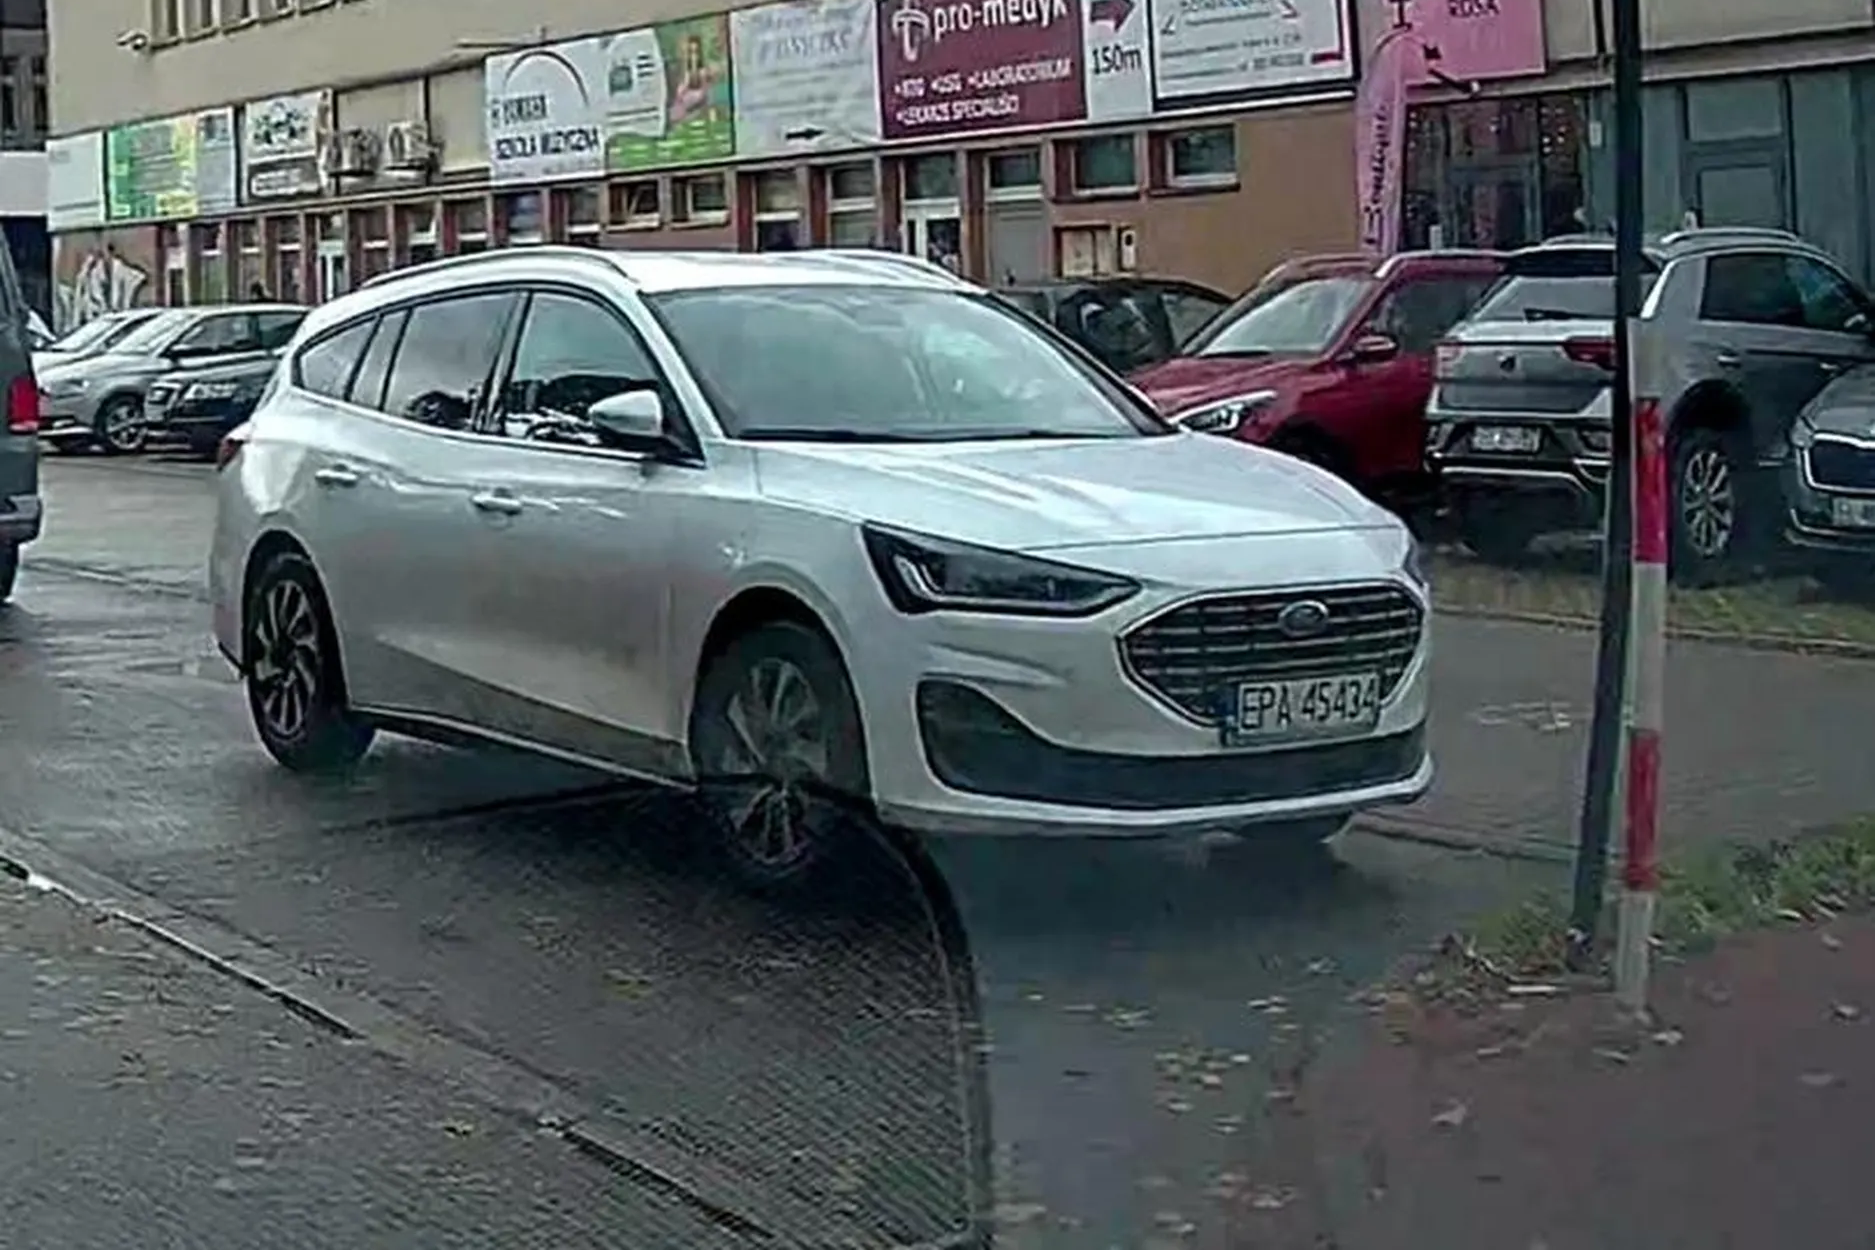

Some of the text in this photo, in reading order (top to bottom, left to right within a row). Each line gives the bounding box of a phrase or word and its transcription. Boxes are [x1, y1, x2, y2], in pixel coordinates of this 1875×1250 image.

[1091, 45, 1142, 76] 150m
[1242, 678, 1377, 729] EPA 45434
